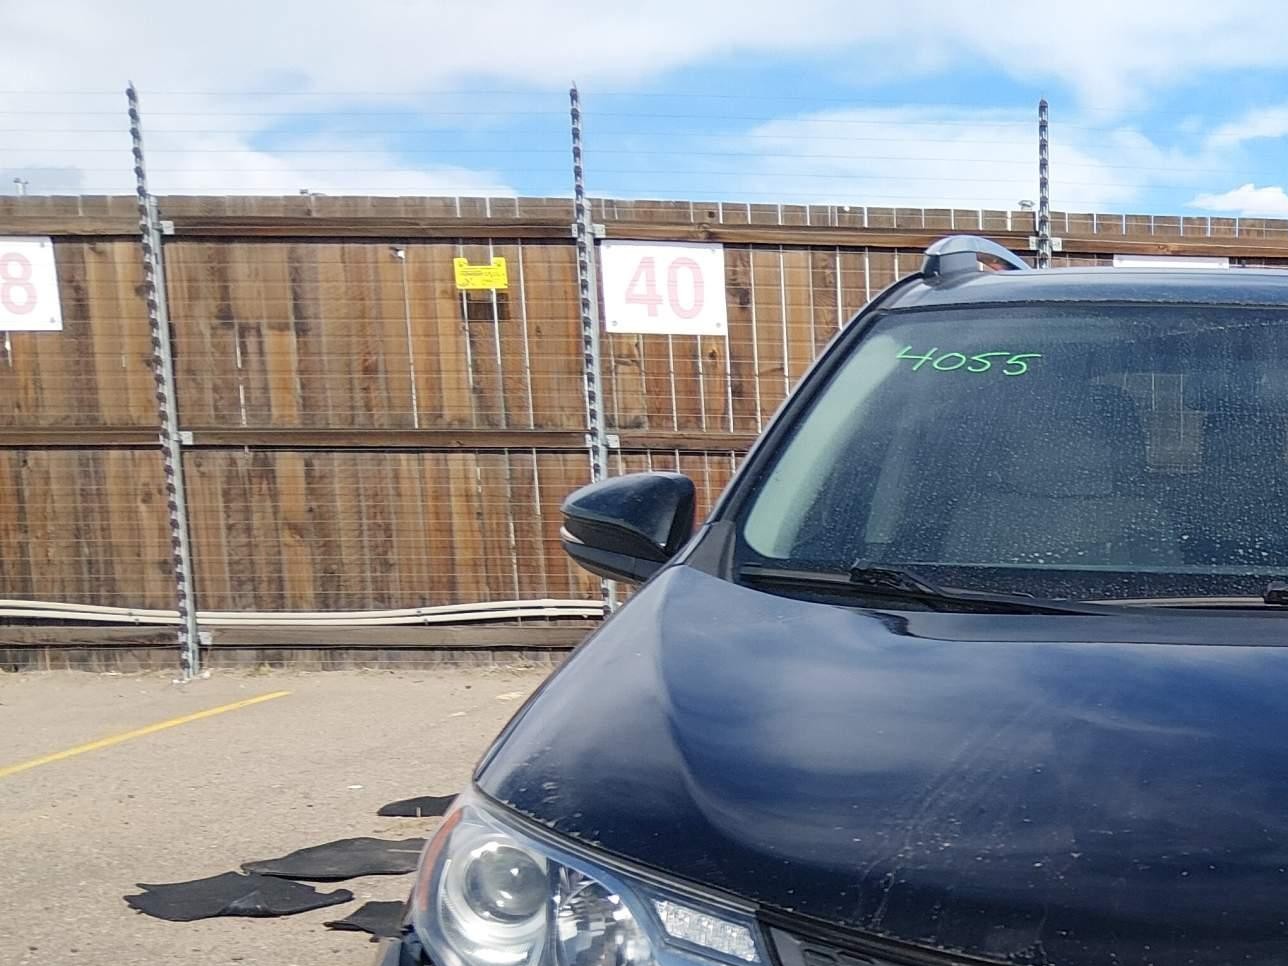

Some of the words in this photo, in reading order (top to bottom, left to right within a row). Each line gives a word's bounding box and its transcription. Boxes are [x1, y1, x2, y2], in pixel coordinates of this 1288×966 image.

[0, 252, 37, 315] 8
[625, 256, 705, 319] 40
[896, 346, 1042, 376] 4055
